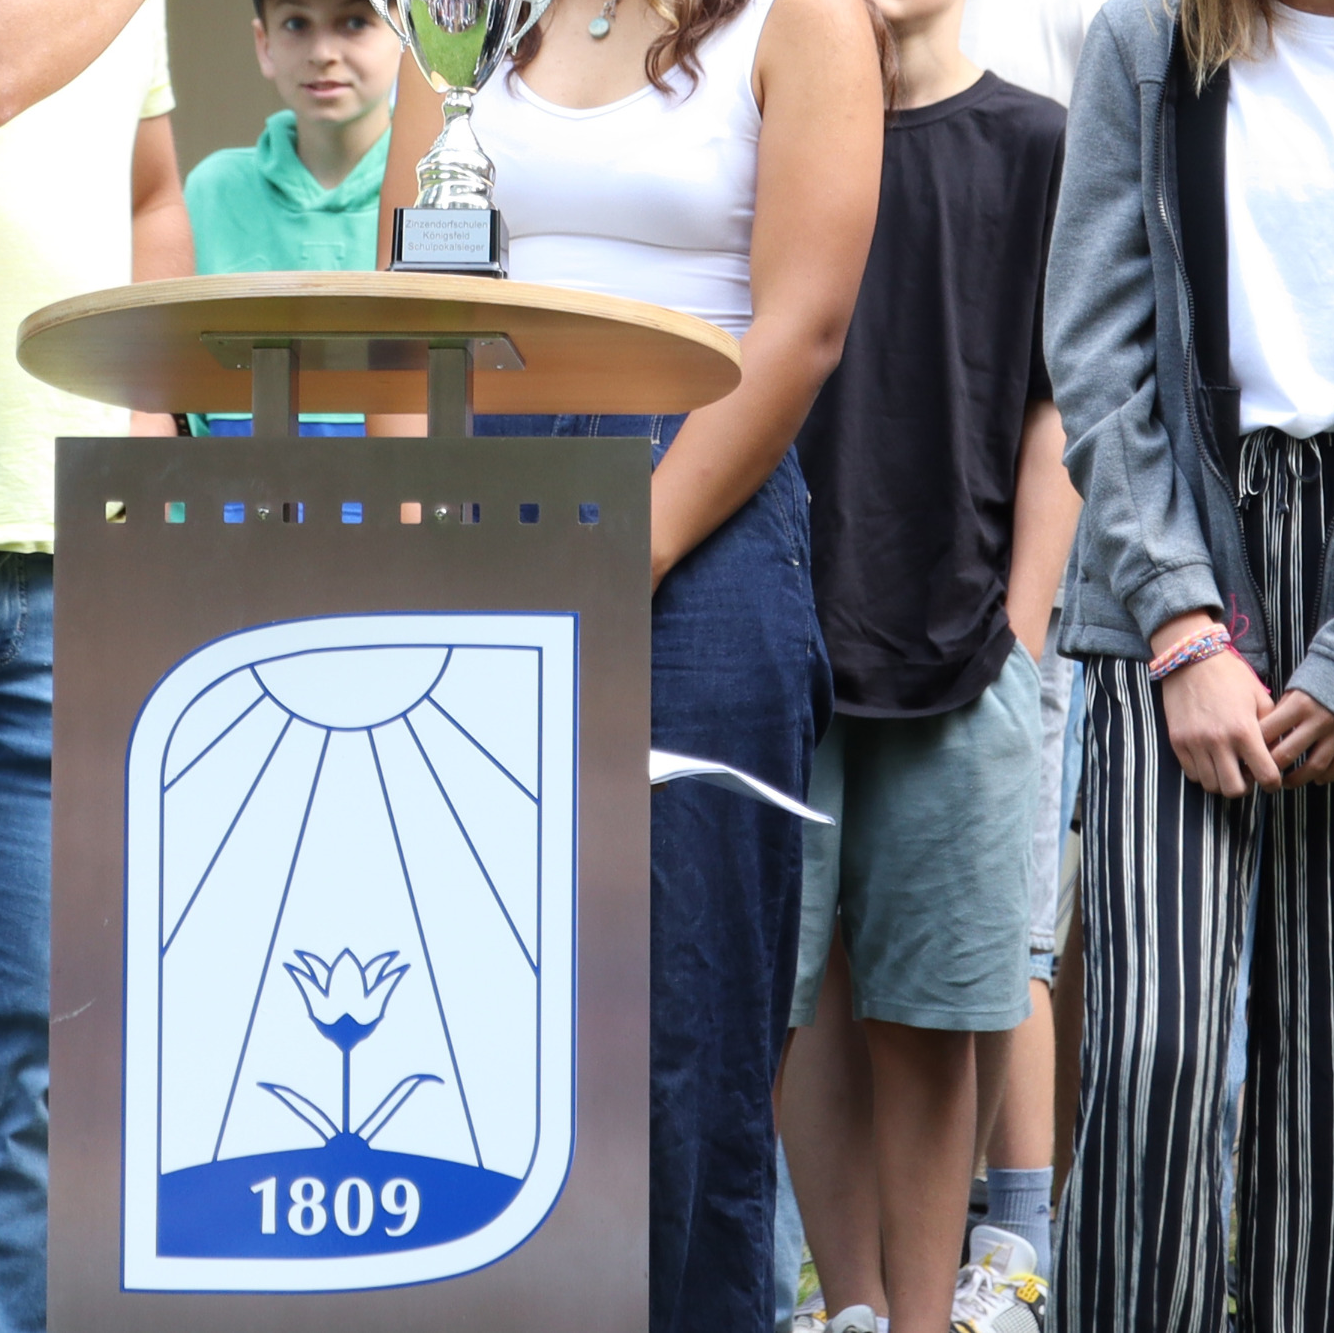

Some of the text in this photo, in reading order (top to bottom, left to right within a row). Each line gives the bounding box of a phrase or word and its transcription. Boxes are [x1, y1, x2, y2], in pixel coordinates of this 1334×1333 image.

[405, 220, 488, 228] Zinzendorfschulen
[423, 231, 470, 241] Königsfeld
[407, 242, 485, 252] Schulpokalsieger
[250, 1176, 421, 1237] 1809
